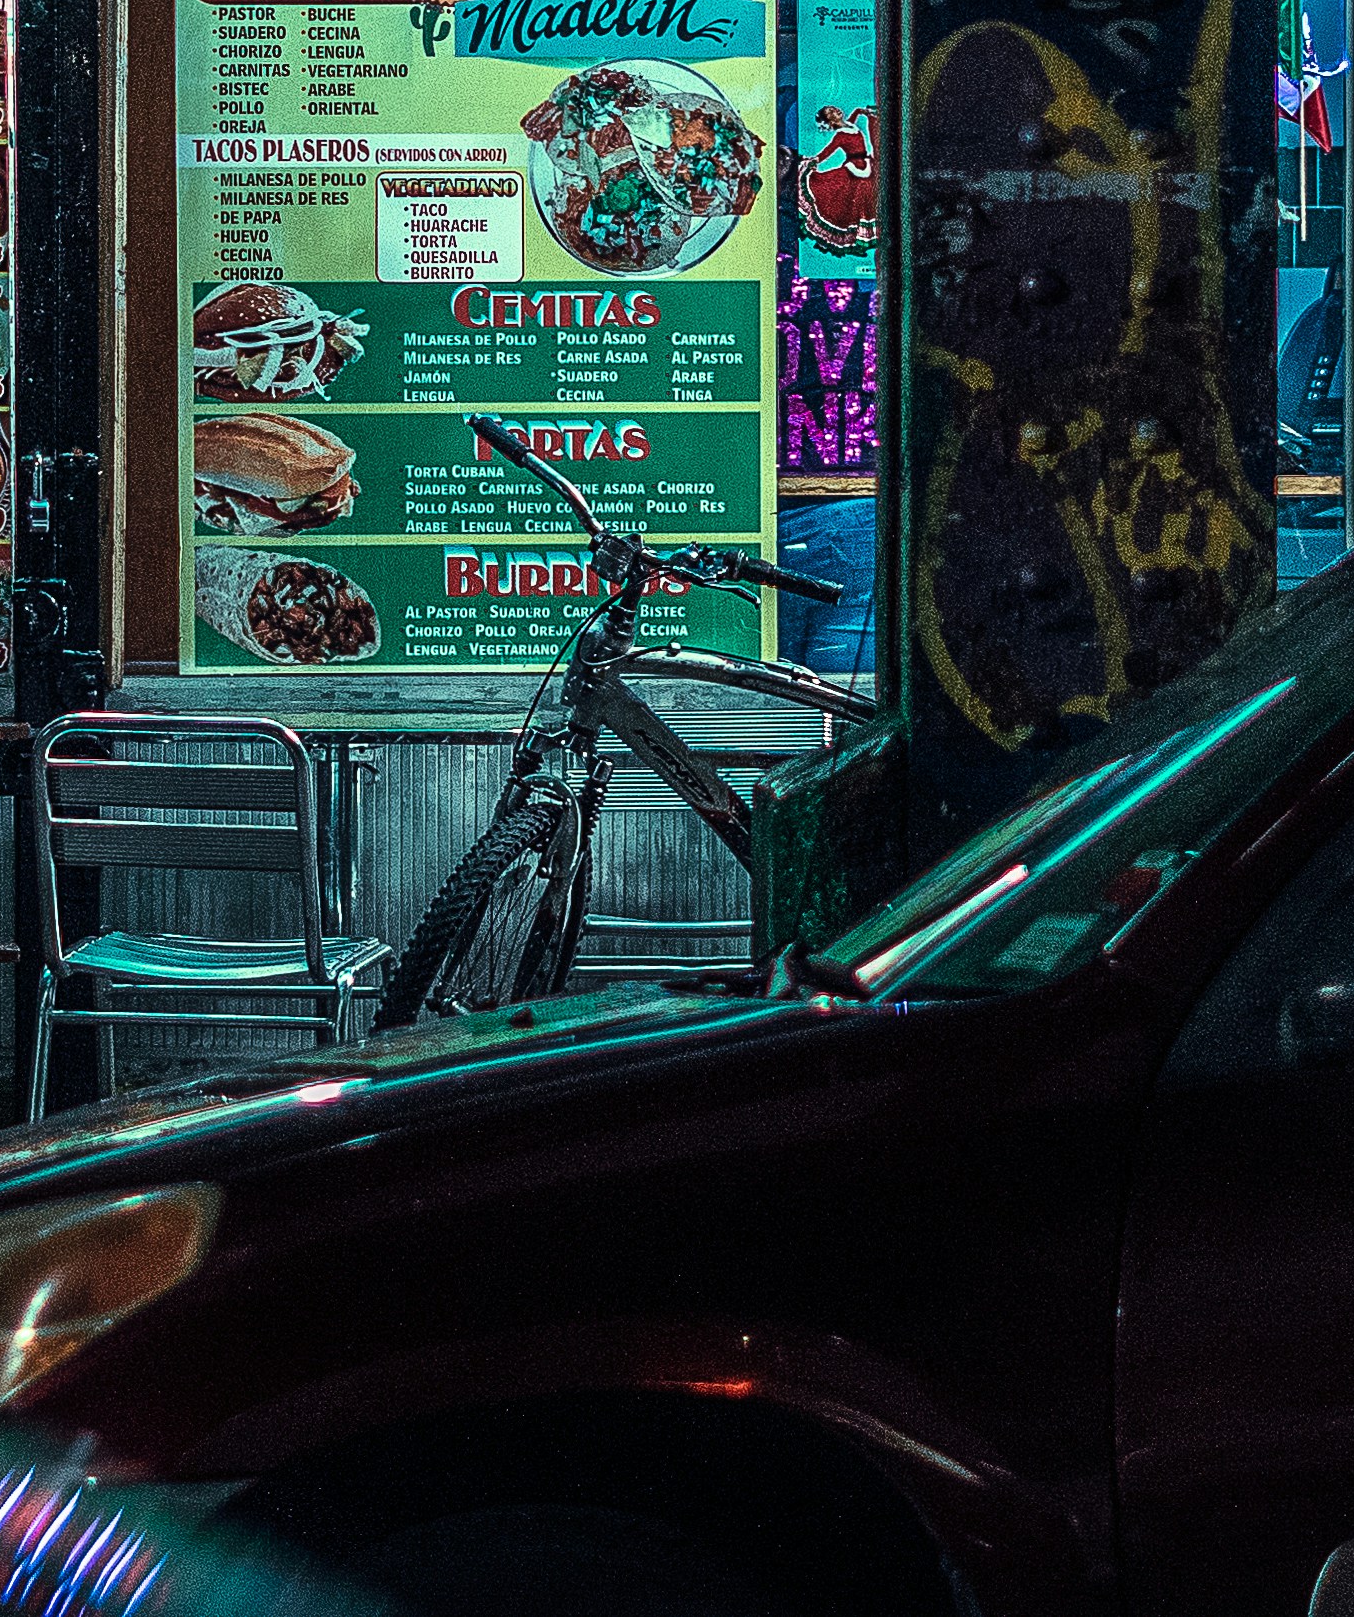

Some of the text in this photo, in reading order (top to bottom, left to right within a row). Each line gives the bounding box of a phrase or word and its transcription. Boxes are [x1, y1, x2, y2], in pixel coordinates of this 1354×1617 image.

[218, 7, 276, 20] PASTOR
[308, 8, 355, 21] BUCHE
[831, 8, 876, 18] CALPULL
[218, 26, 287, 39] SUADERO
[308, 27, 360, 40] CECINA
[219, 45, 282, 58] CHORIZO
[308, 46, 365, 59] LENGUA
[219, 64, 290, 77] CARNITAS
[308, 64, 408, 78] VEGETARIANO
[219, 83, 269, 95] BISTEC
[308, 83, 355, 96] ARABE
[219, 101, 264, 114] POLLO
[308, 102, 378, 115] ORIENTAL
[219, 120, 266, 133] OREJA
[192, 139, 507, 164] TACOS PLASEROS (SERVIDOS CON ARROZ)
[220, 174, 367, 186] MILANESA DE POLLO
[380, 178, 518, 198] VEGETARIANO
[220, 192, 349, 205] MILANESA DE RES
[411, 204, 447, 216] TACO
[220, 211, 282, 224] DE PAPA
[411, 219, 488, 233] HUARACHE
[220, 230, 268, 243] HUEVO
[411, 235, 457, 248] TORTA
[220, 249, 272, 262] CECINA
[411, 251, 498, 264] QUESADILLA
[220, 267, 283, 280] CHORIZO
[411, 267, 474, 280] BURRITO
[450, 284, 662, 329] CEMITAS
[445, 545, 691, 597] BURRIS
